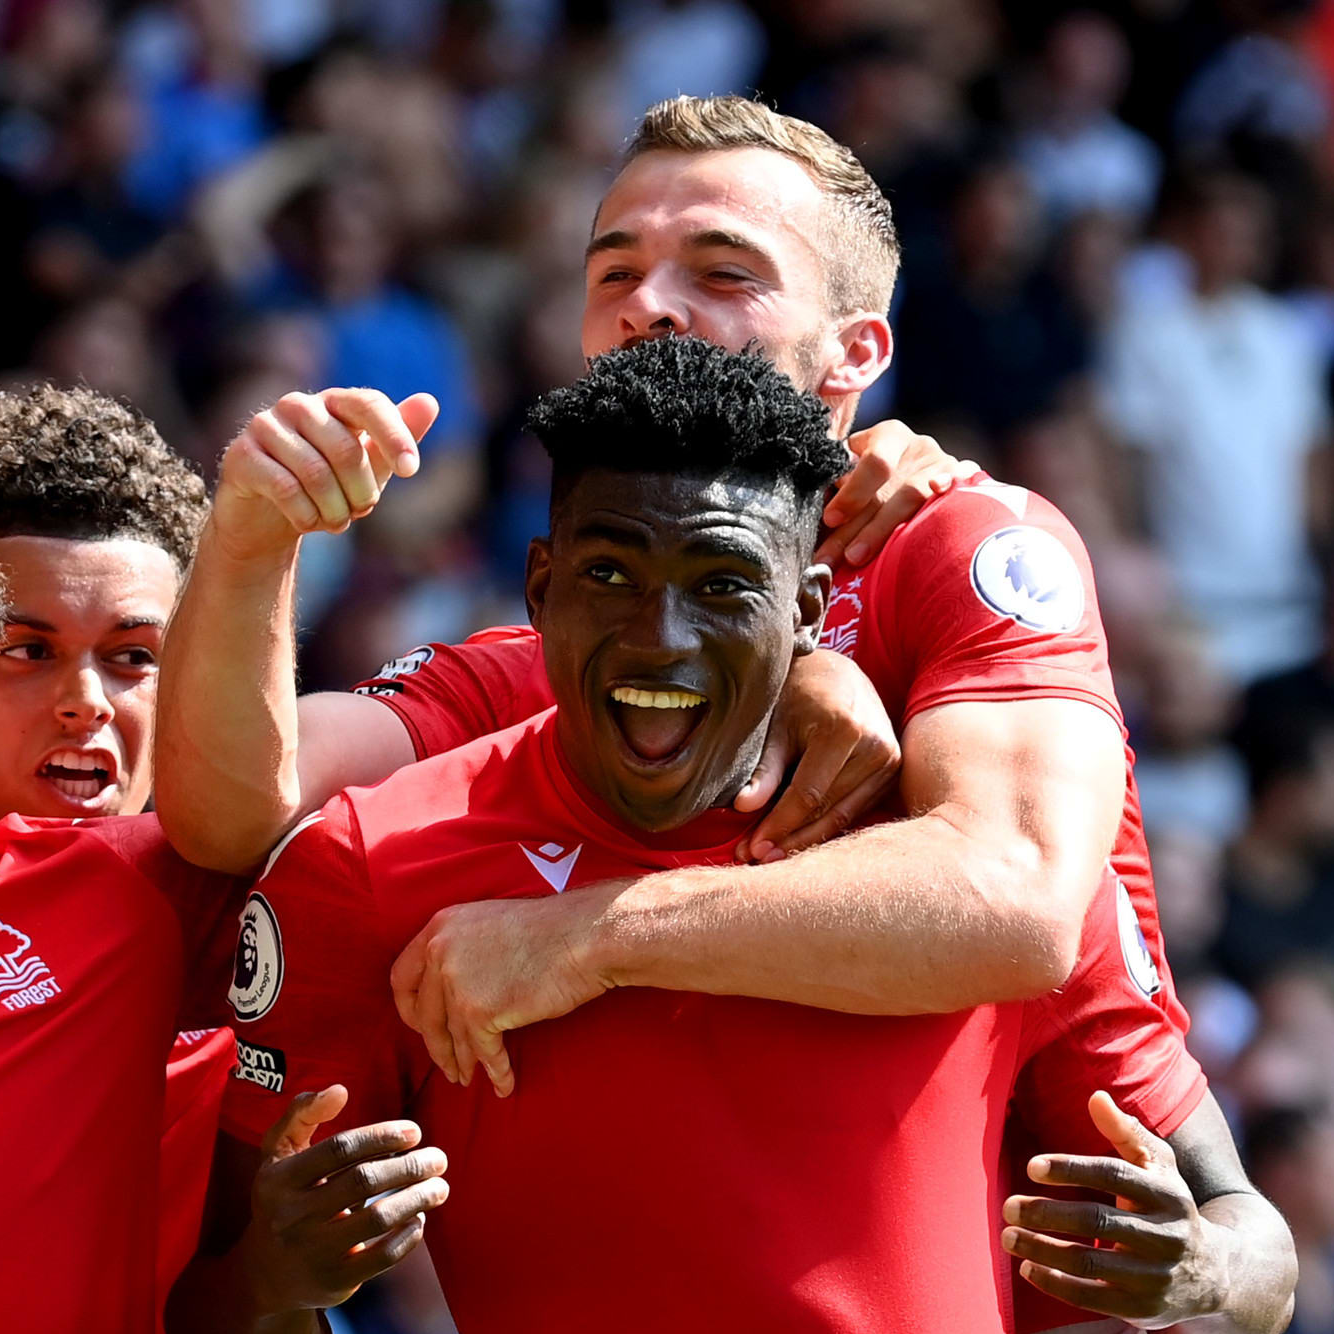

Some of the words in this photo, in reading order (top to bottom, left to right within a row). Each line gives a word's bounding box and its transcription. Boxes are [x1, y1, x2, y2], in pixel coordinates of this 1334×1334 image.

[255, 961, 272, 998] League
[237, 1041, 277, 1070] oom
[235, 1063, 284, 1093] acism
